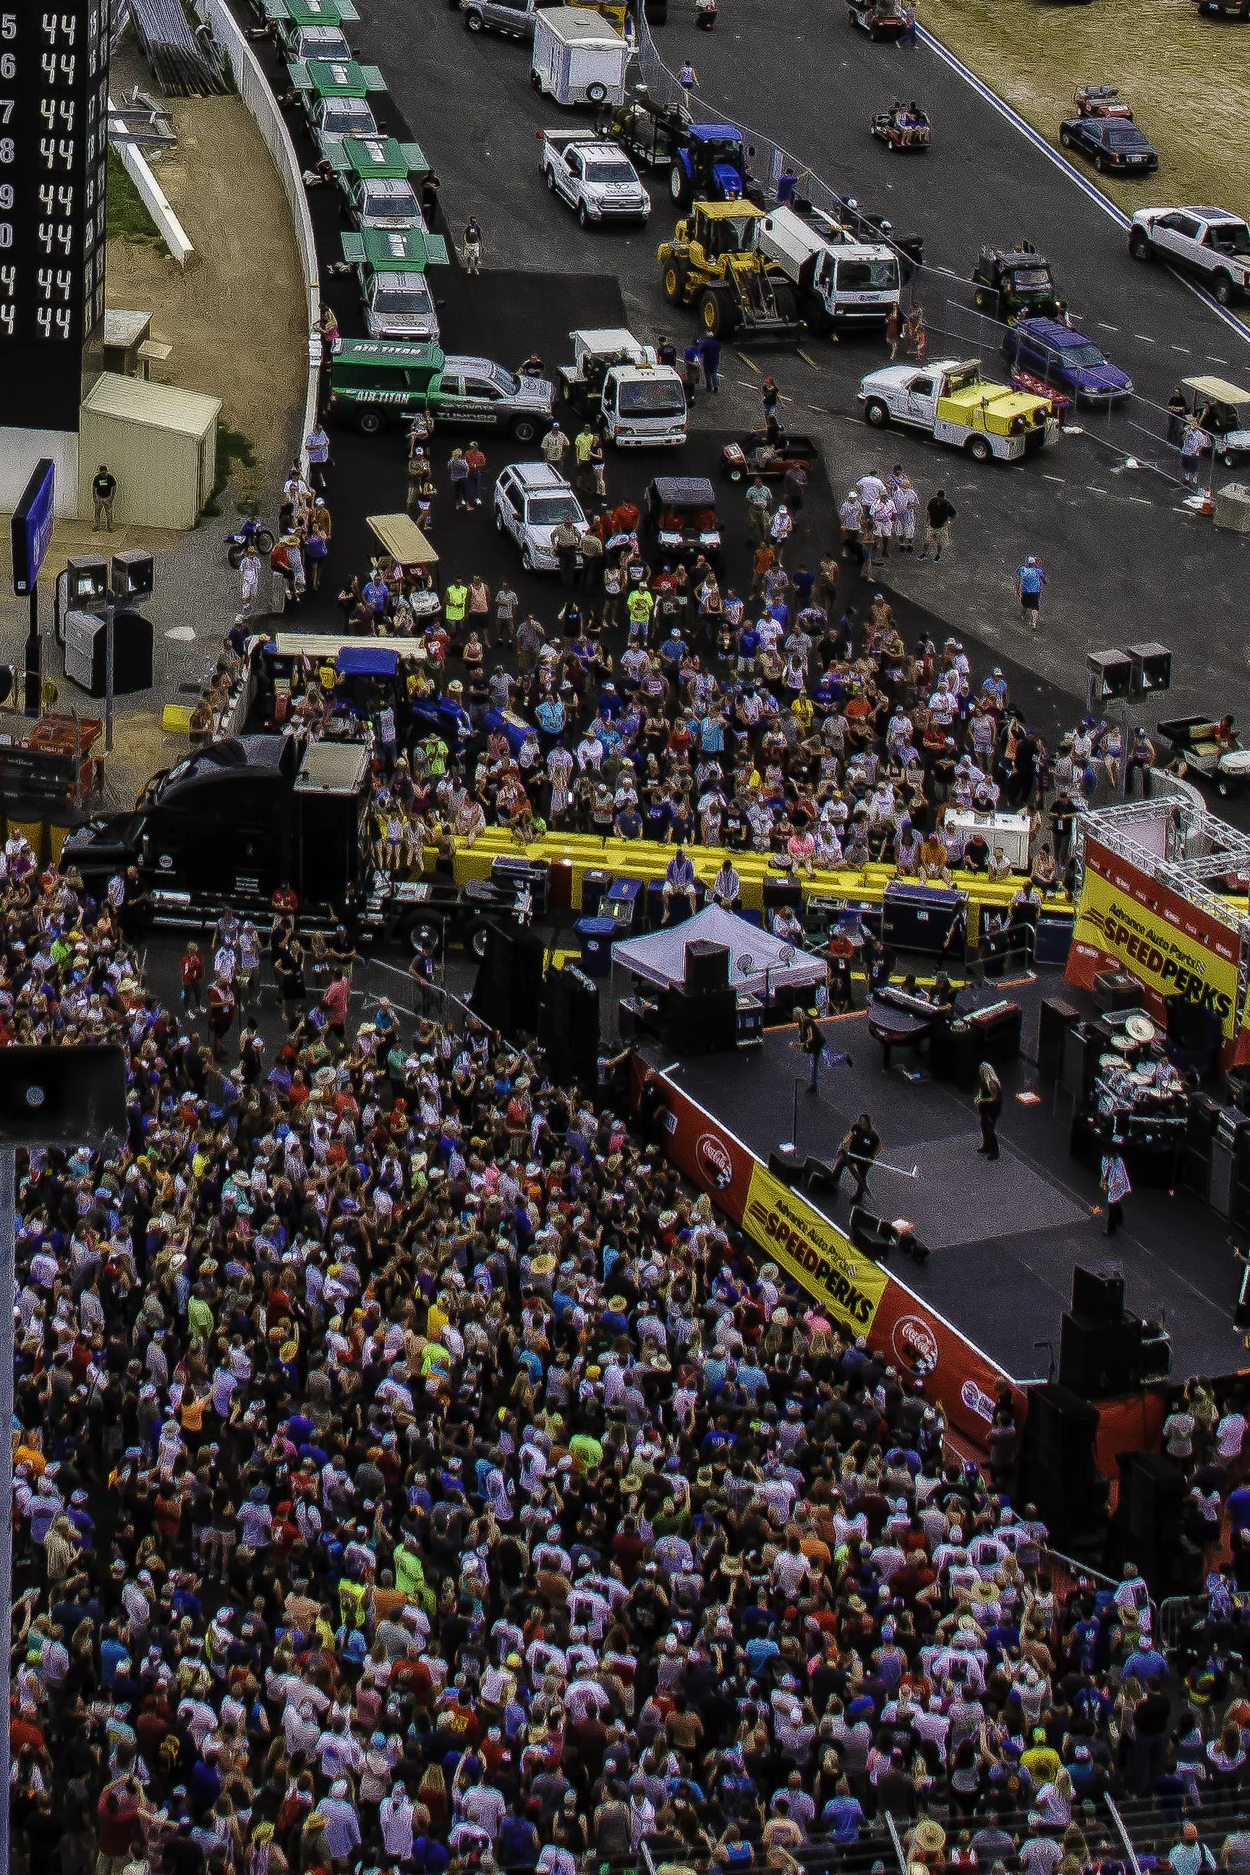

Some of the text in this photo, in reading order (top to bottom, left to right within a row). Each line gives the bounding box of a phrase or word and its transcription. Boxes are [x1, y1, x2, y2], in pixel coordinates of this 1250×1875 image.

[43, 14, 75, 45] 44
[42, 53, 75, 85] 44
[41, 99, 74, 131] 44
[40, 138, 74, 169] 44
[39, 185, 73, 216] 44
[39, 223, 72, 255] 44
[38, 269, 71, 300] 44
[37, 307, 70, 338] 44
[356, 391, 377, 402] AIR
[379, 391, 410, 404] TITAN
[1109, 902, 1197, 968] Advance Auto Parts
[807, 1228, 829, 1251] Auto
